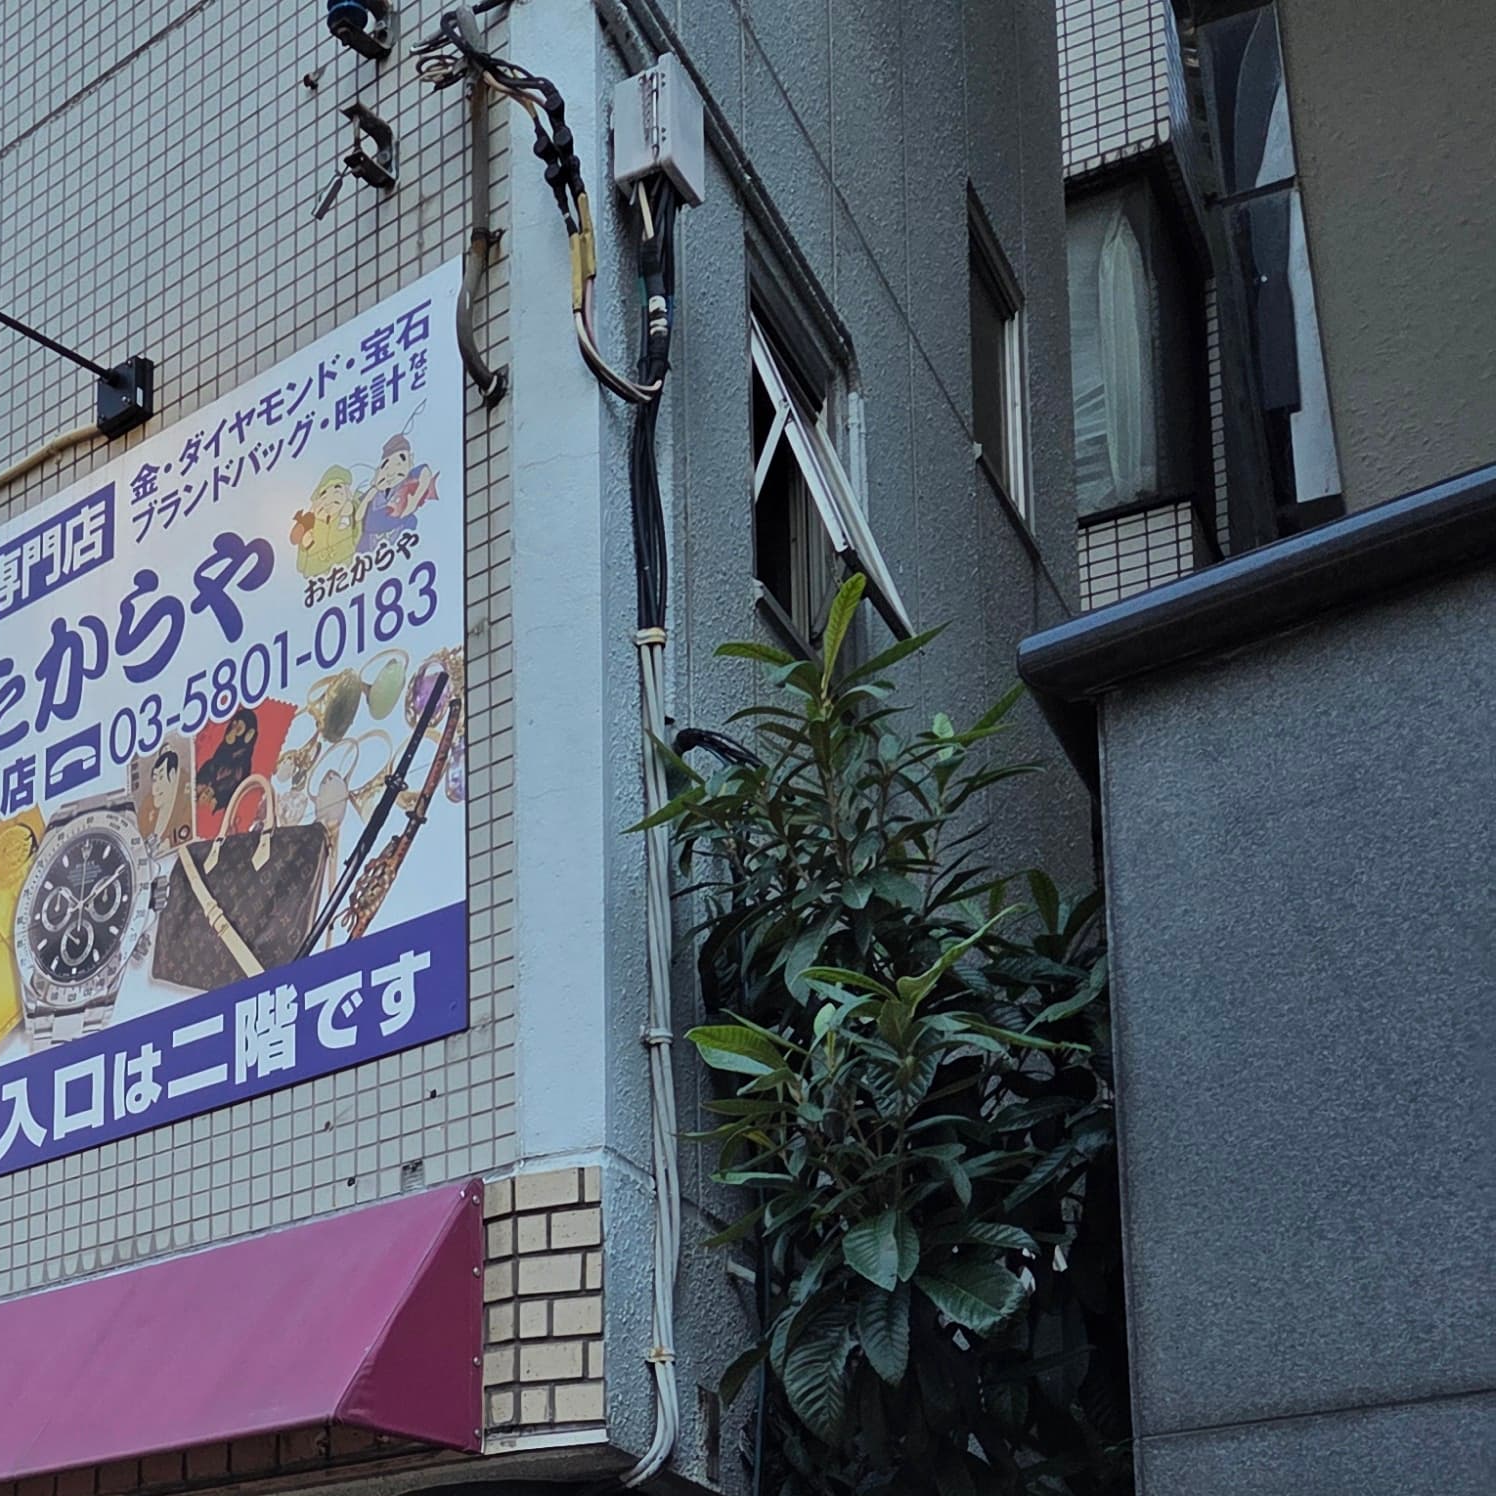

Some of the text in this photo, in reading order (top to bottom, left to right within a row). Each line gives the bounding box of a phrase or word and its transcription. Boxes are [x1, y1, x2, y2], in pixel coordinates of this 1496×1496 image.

[131, 300, 432, 503] 金・ダイヤモンド・宝石
[109, 561, 438, 765] 03-5801-0183
[304, 532, 420, 608] おたからや
